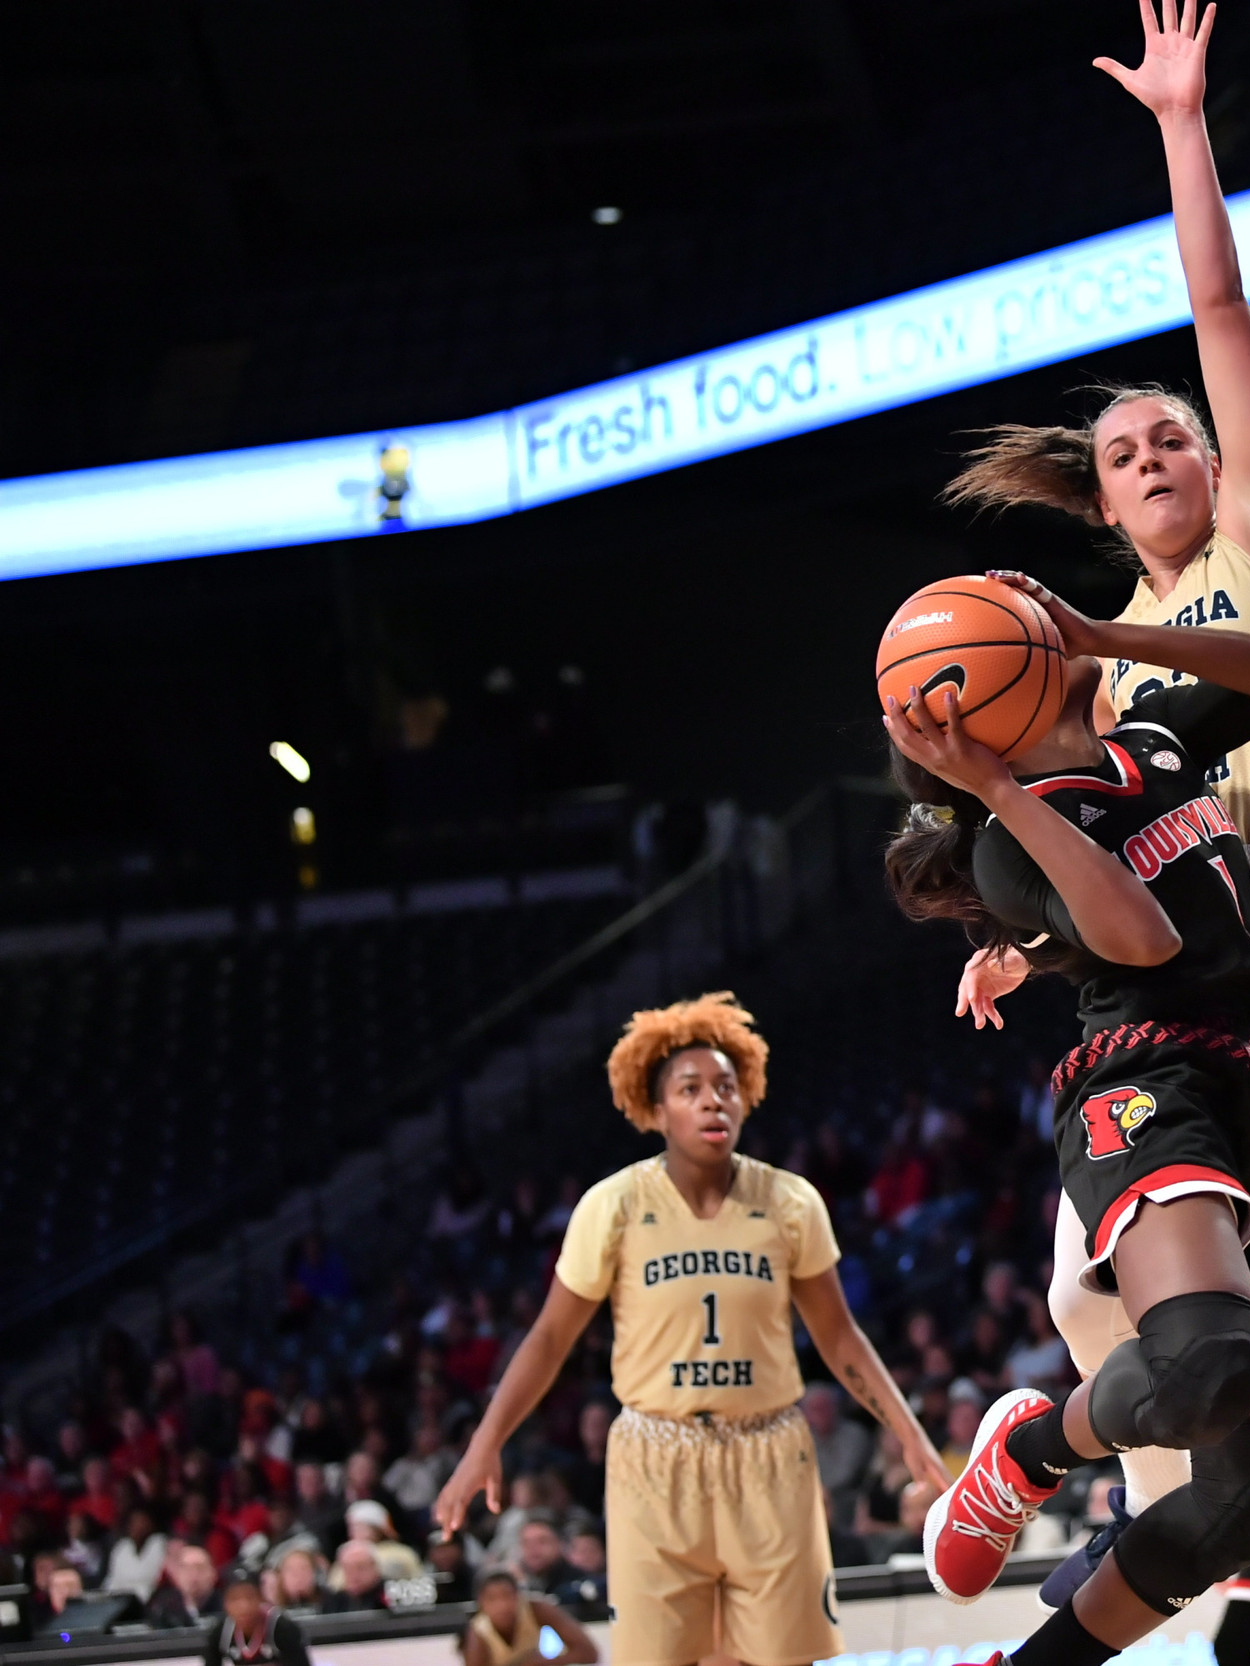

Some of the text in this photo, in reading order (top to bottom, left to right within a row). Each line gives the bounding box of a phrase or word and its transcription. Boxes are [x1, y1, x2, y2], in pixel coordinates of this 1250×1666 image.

[526, 249, 1170, 482] Fresh food. Low prices
[644, 1251, 773, 1286] GEORGIA
[702, 1292, 720, 1345] 1
[671, 1360, 753, 1387] TECH
